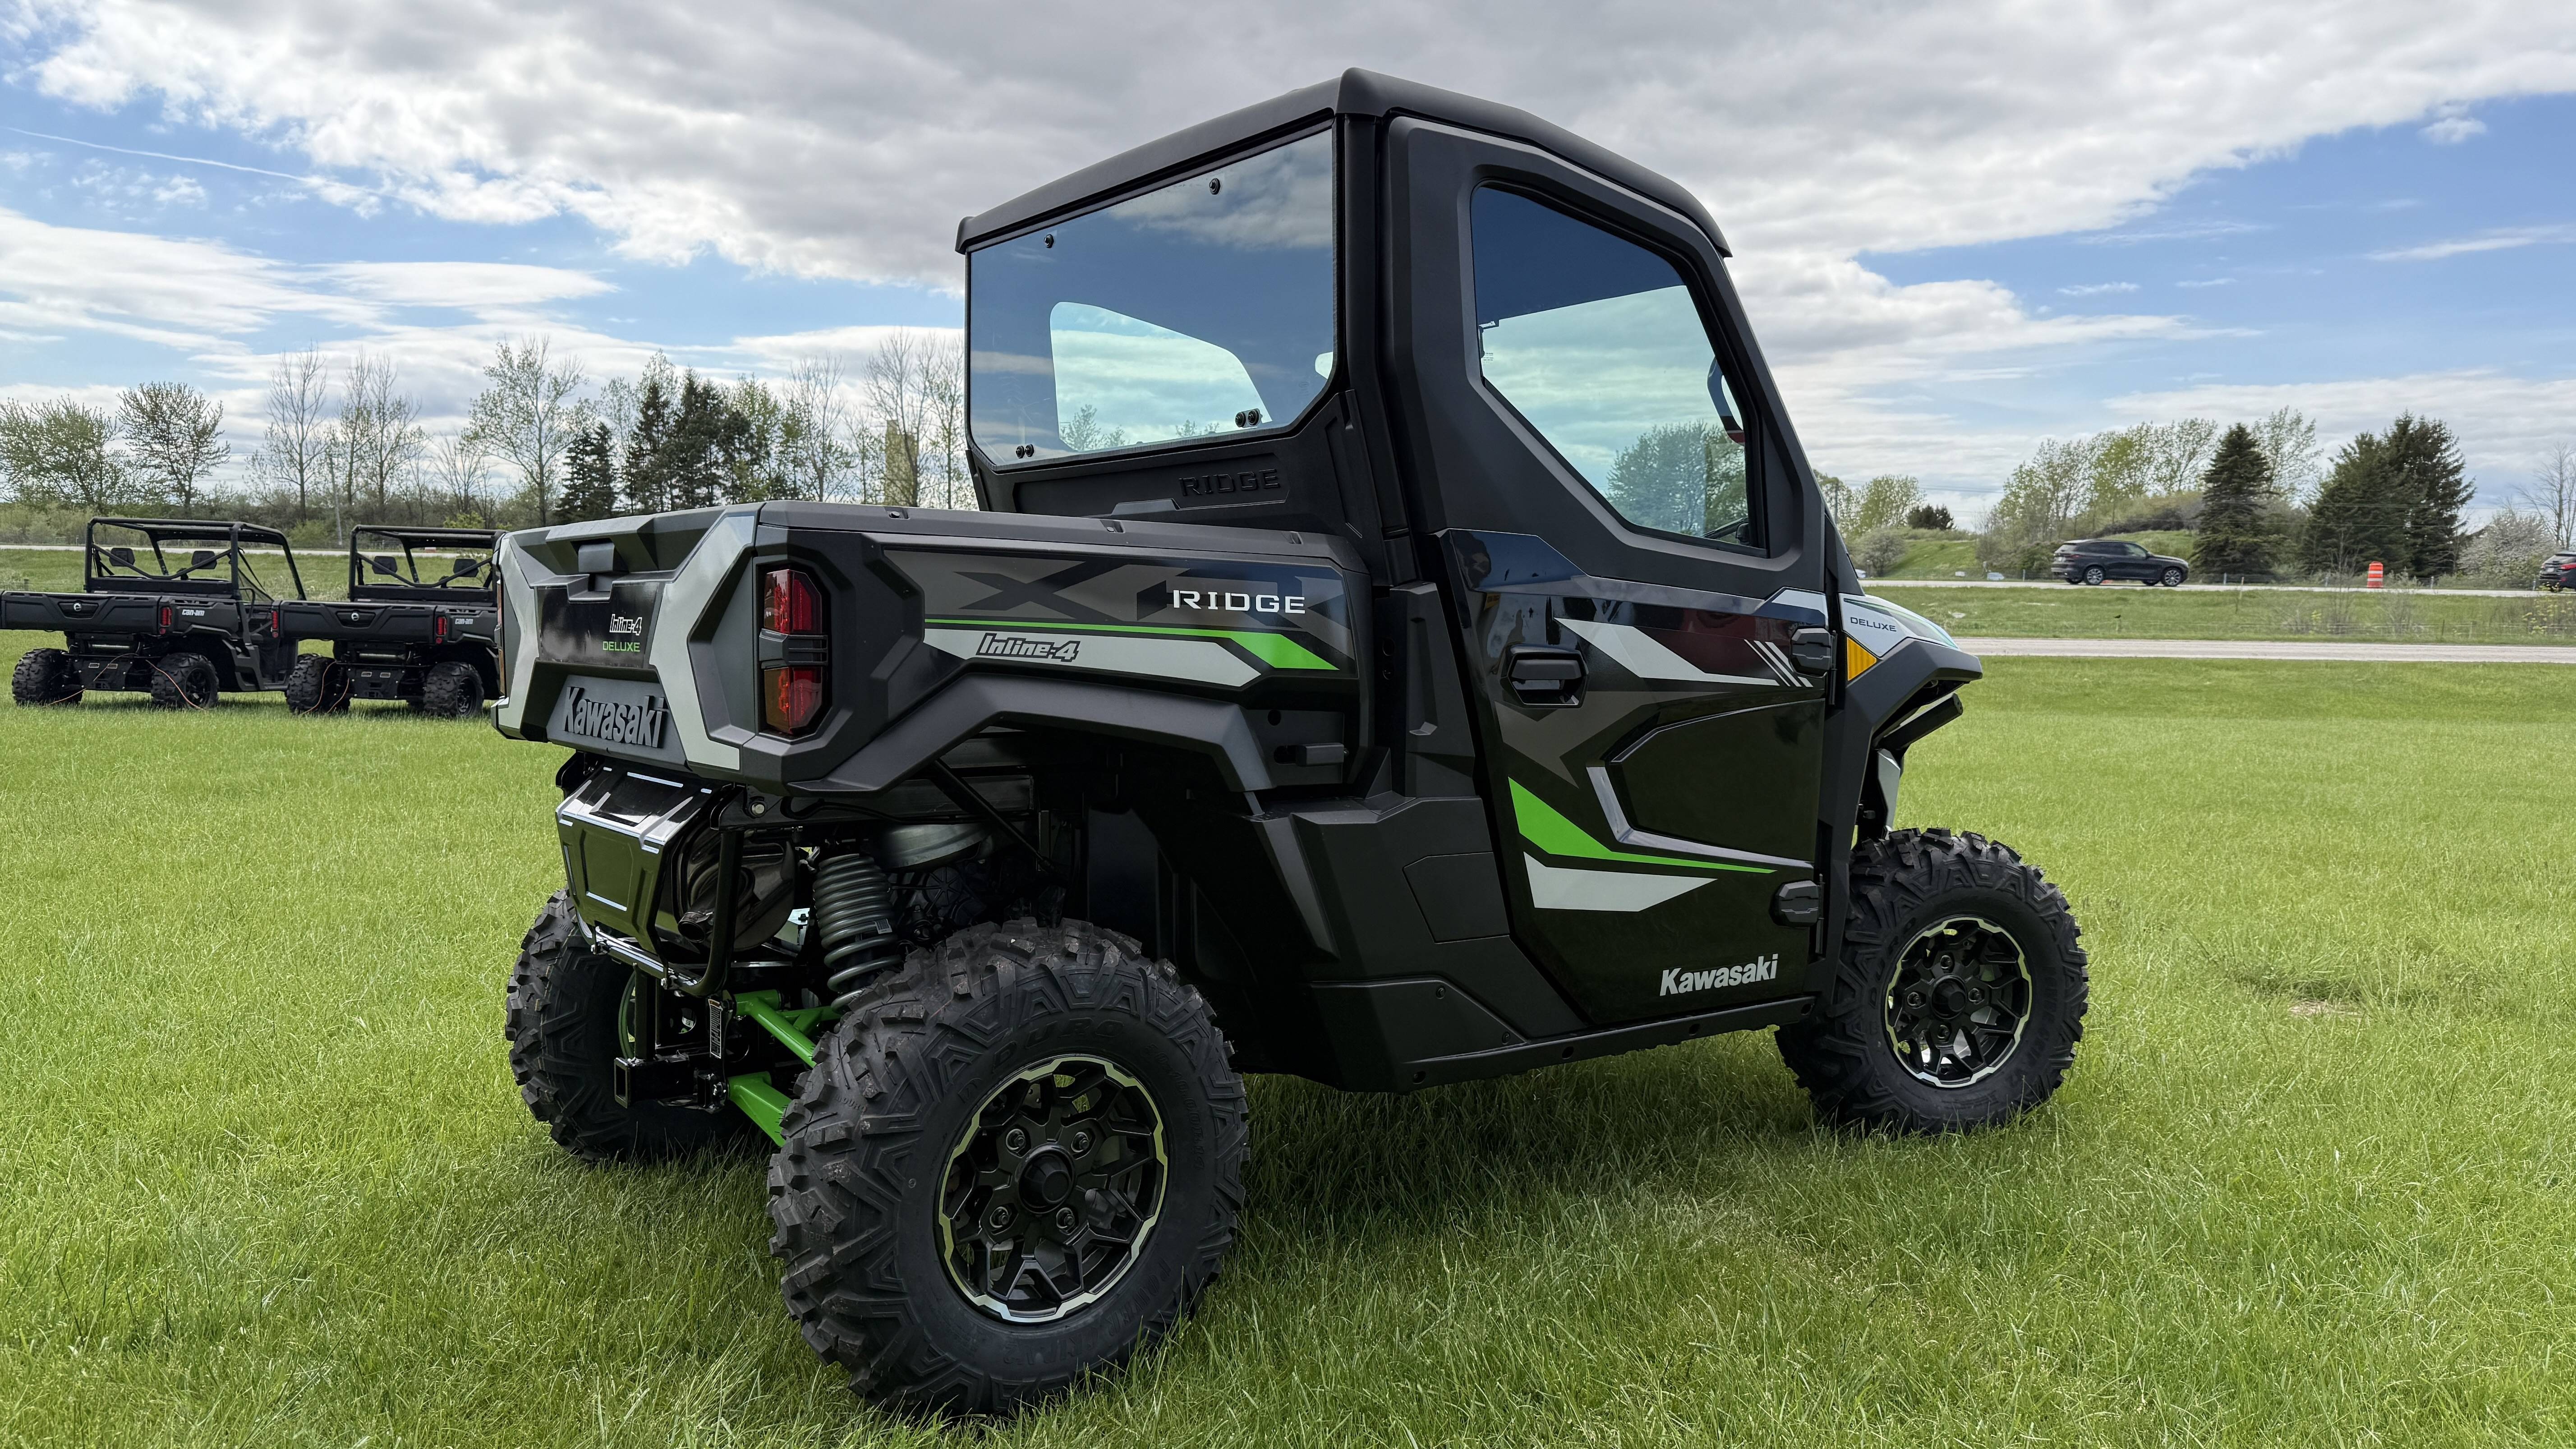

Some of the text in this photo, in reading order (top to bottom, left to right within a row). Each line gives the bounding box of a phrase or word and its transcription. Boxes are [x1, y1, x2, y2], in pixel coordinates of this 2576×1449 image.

[1178, 469, 1281, 496] RIDGE
[1173, 590, 1306, 614] RIDGE
[1850, 617, 1897, 632] DELUXE
[603, 641, 640, 652] DELUXE
[976, 633, 1081, 662] Inline-4
[564, 687, 667, 748] Kawasaki
[1660, 953, 1778, 996] Kawasaki
[992, 1017, 1125, 1074] DURO
